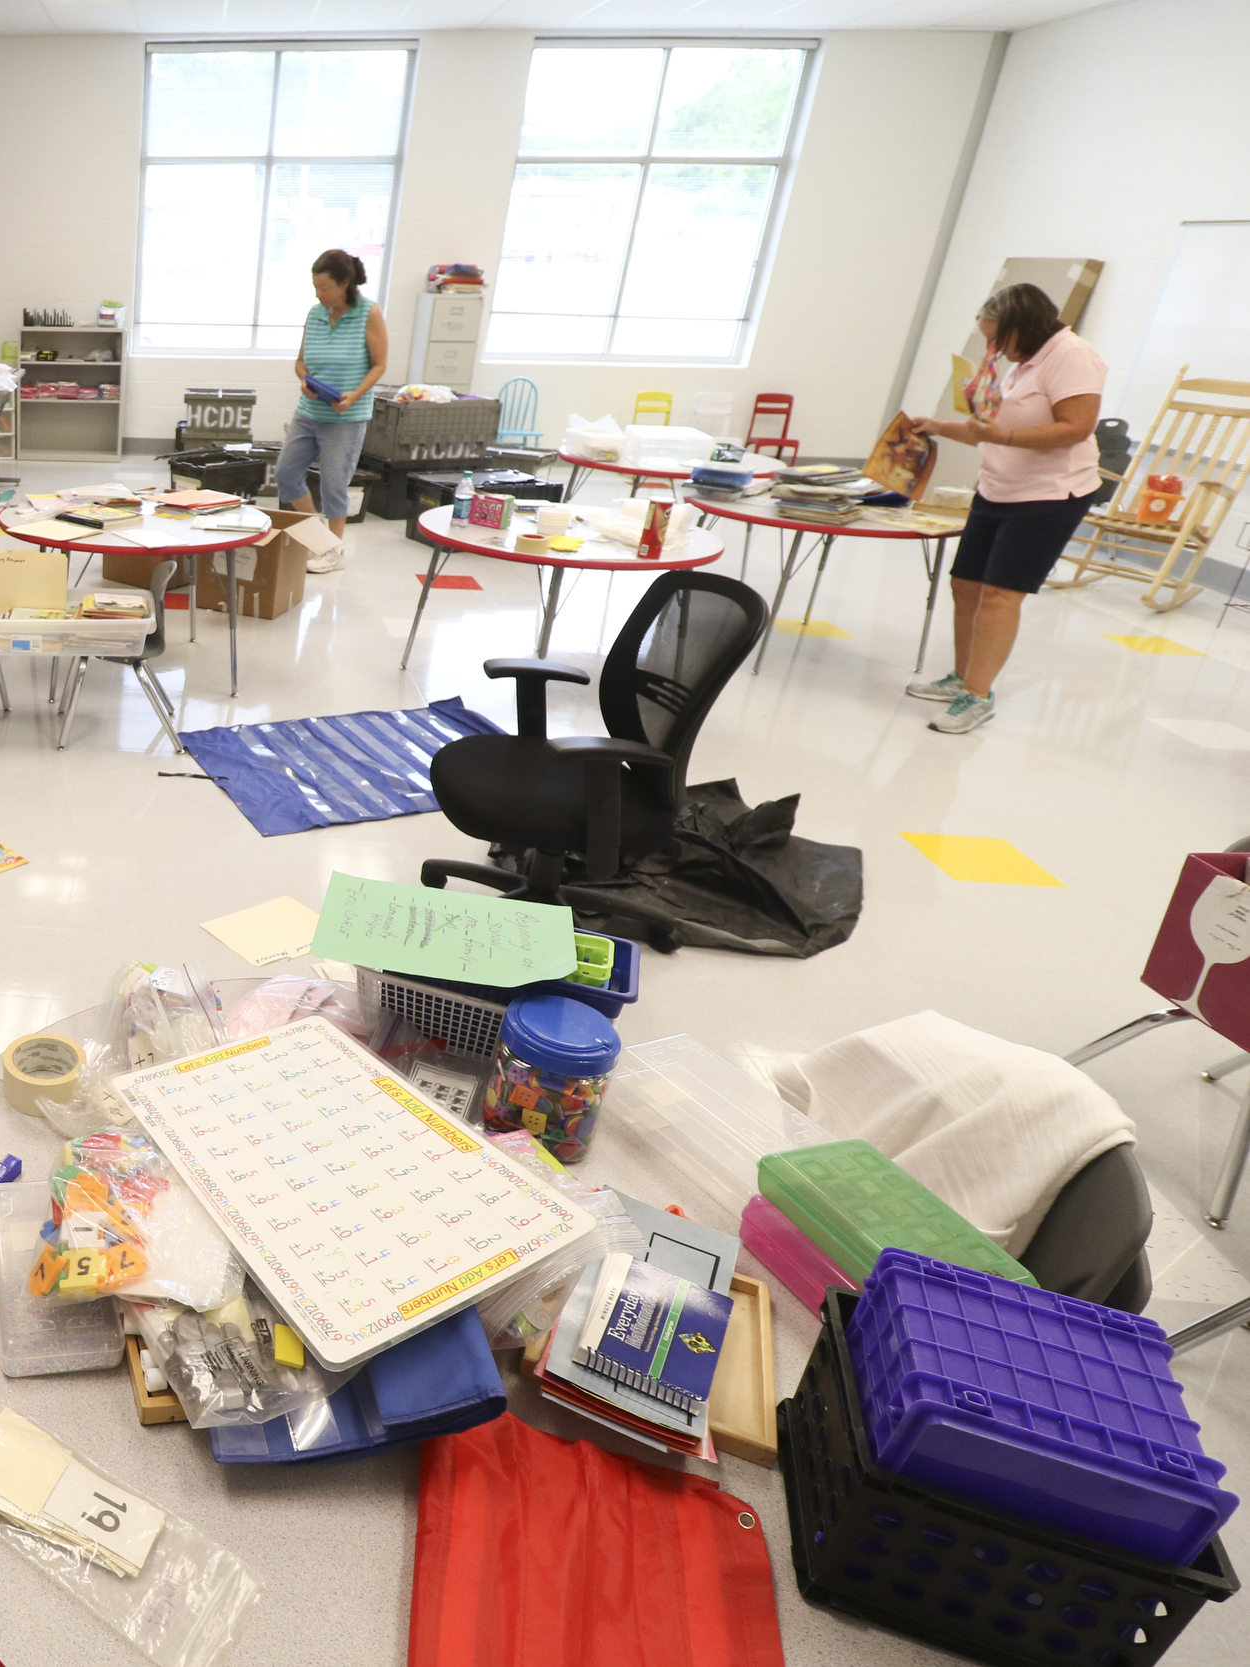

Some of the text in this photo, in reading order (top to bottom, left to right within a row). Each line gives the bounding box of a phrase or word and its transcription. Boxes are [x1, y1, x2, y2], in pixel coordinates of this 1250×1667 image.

[187, 405, 252, 429] HCDE
[178, 1039, 269, 1072] Let's Add Numbers
[376, 1078, 404, 1097] Let's
[402, 1098, 426, 1114] Add
[423, 1114, 473, 1152] Numbers
[77, 1256, 92, 1276] 5
[401, 1251, 517, 1315] Let's Add Numbers
[601, 1300, 611, 1320] MINUTE
[607, 1288, 642, 1342] Everyday
[81, 1491, 127, 1533] 19
